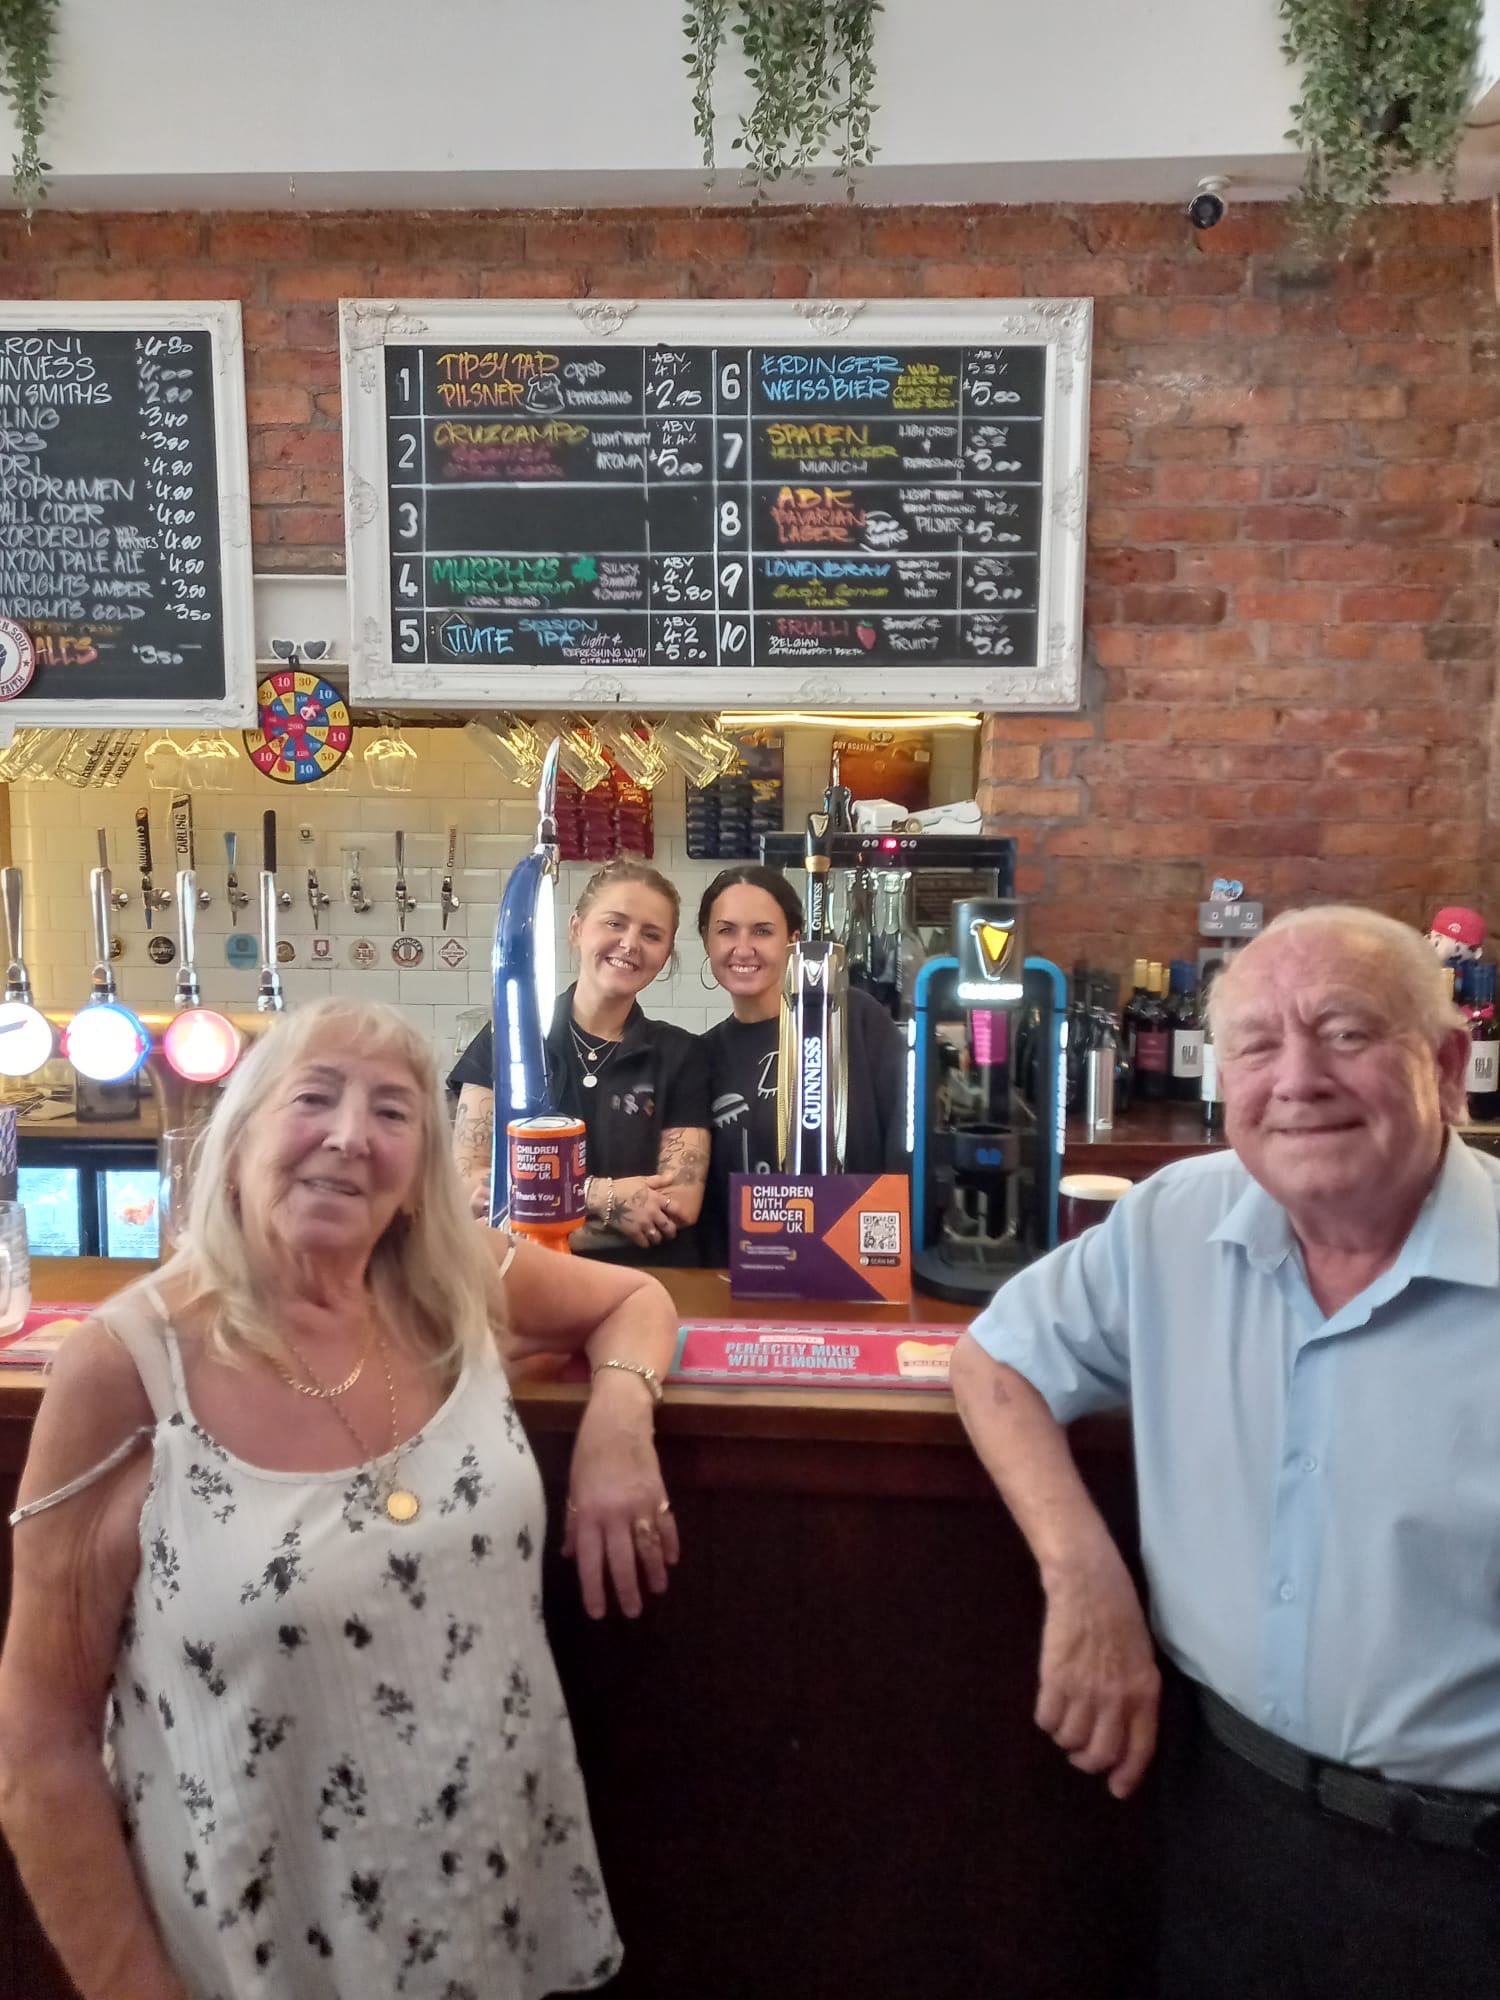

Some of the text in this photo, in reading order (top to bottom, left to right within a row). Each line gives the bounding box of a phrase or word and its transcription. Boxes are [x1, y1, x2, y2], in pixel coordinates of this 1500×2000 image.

[0, 336, 82, 356] RONI
[436, 350, 560, 381] TIPSY TAP
[651, 352, 687, 364] ABV
[761, 353, 904, 375] ERDINGER
[399, 367, 411, 401] 1
[720, 362, 741, 400] 6
[25, 382, 113, 405] SMITHS
[436, 378, 526, 408] PILSNER
[434, 420, 591, 447] CRUZCAMPO
[662, 420, 696, 432] ABV
[767, 423, 868, 446] SPATEN
[398, 433, 418, 468] 2
[722, 432, 744, 469] 7
[800, 460, 868, 474] MUNICH
[0, 500, 34, 524] ALL
[40, 501, 105, 525] CIDER
[398, 502, 418, 538] 3
[719, 500, 742, 537] 8
[59, 549, 110, 574] PALE
[113, 551, 146, 574] ALE
[663, 557, 695, 569] ABV
[399, 563, 418, 597] 4
[663, 568, 694, 585] 4.1
[720, 562, 744, 598] 9
[92, 580, 154, 598] AMBER
[92, 603, 146, 620] GOLD
[518, 617, 598, 633] SESSION
[663, 616, 697, 628] ABV
[11, 627, 29, 654] SOUL
[399, 618, 420, 653] 5
[537, 630, 576, 648] IPA
[663, 627, 700, 644] 4.2
[720, 621, 747, 652] 10
[769, 635, 819, 649] BELGIAN
[562, 647, 622, 659] REFRESHING
[1, 675, 26, 696] FAITH
[277, 677, 291, 688] 10
[319, 689, 333, 700] 10
[332, 732, 346, 742] 10
[260, 752, 273, 762] 10
[300, 764, 314, 774] 10
[175, 814, 189, 854] CARLING
[811, 881, 824, 932] GUINNESS
[802, 1035, 823, 1131] GUINNESS
[516, 1145, 559, 1155] CHILDREN
[516, 1154, 536, 1163] WITH
[516, 1163, 552, 1172] CANCER
[538, 1171, 551, 1180] UK
[515, 1190, 555, 1201] Thank You
[752, 1185, 814, 1198] CHILDREN
[753, 1197, 783, 1210] WITH
[752, 1210, 803, 1222] CANCER
[786, 1221, 803, 1234] UK
[725, 1342, 860, 1357] PERFECTLY MIXED
[727, 1354, 857, 1370] WITH LEMONADE
